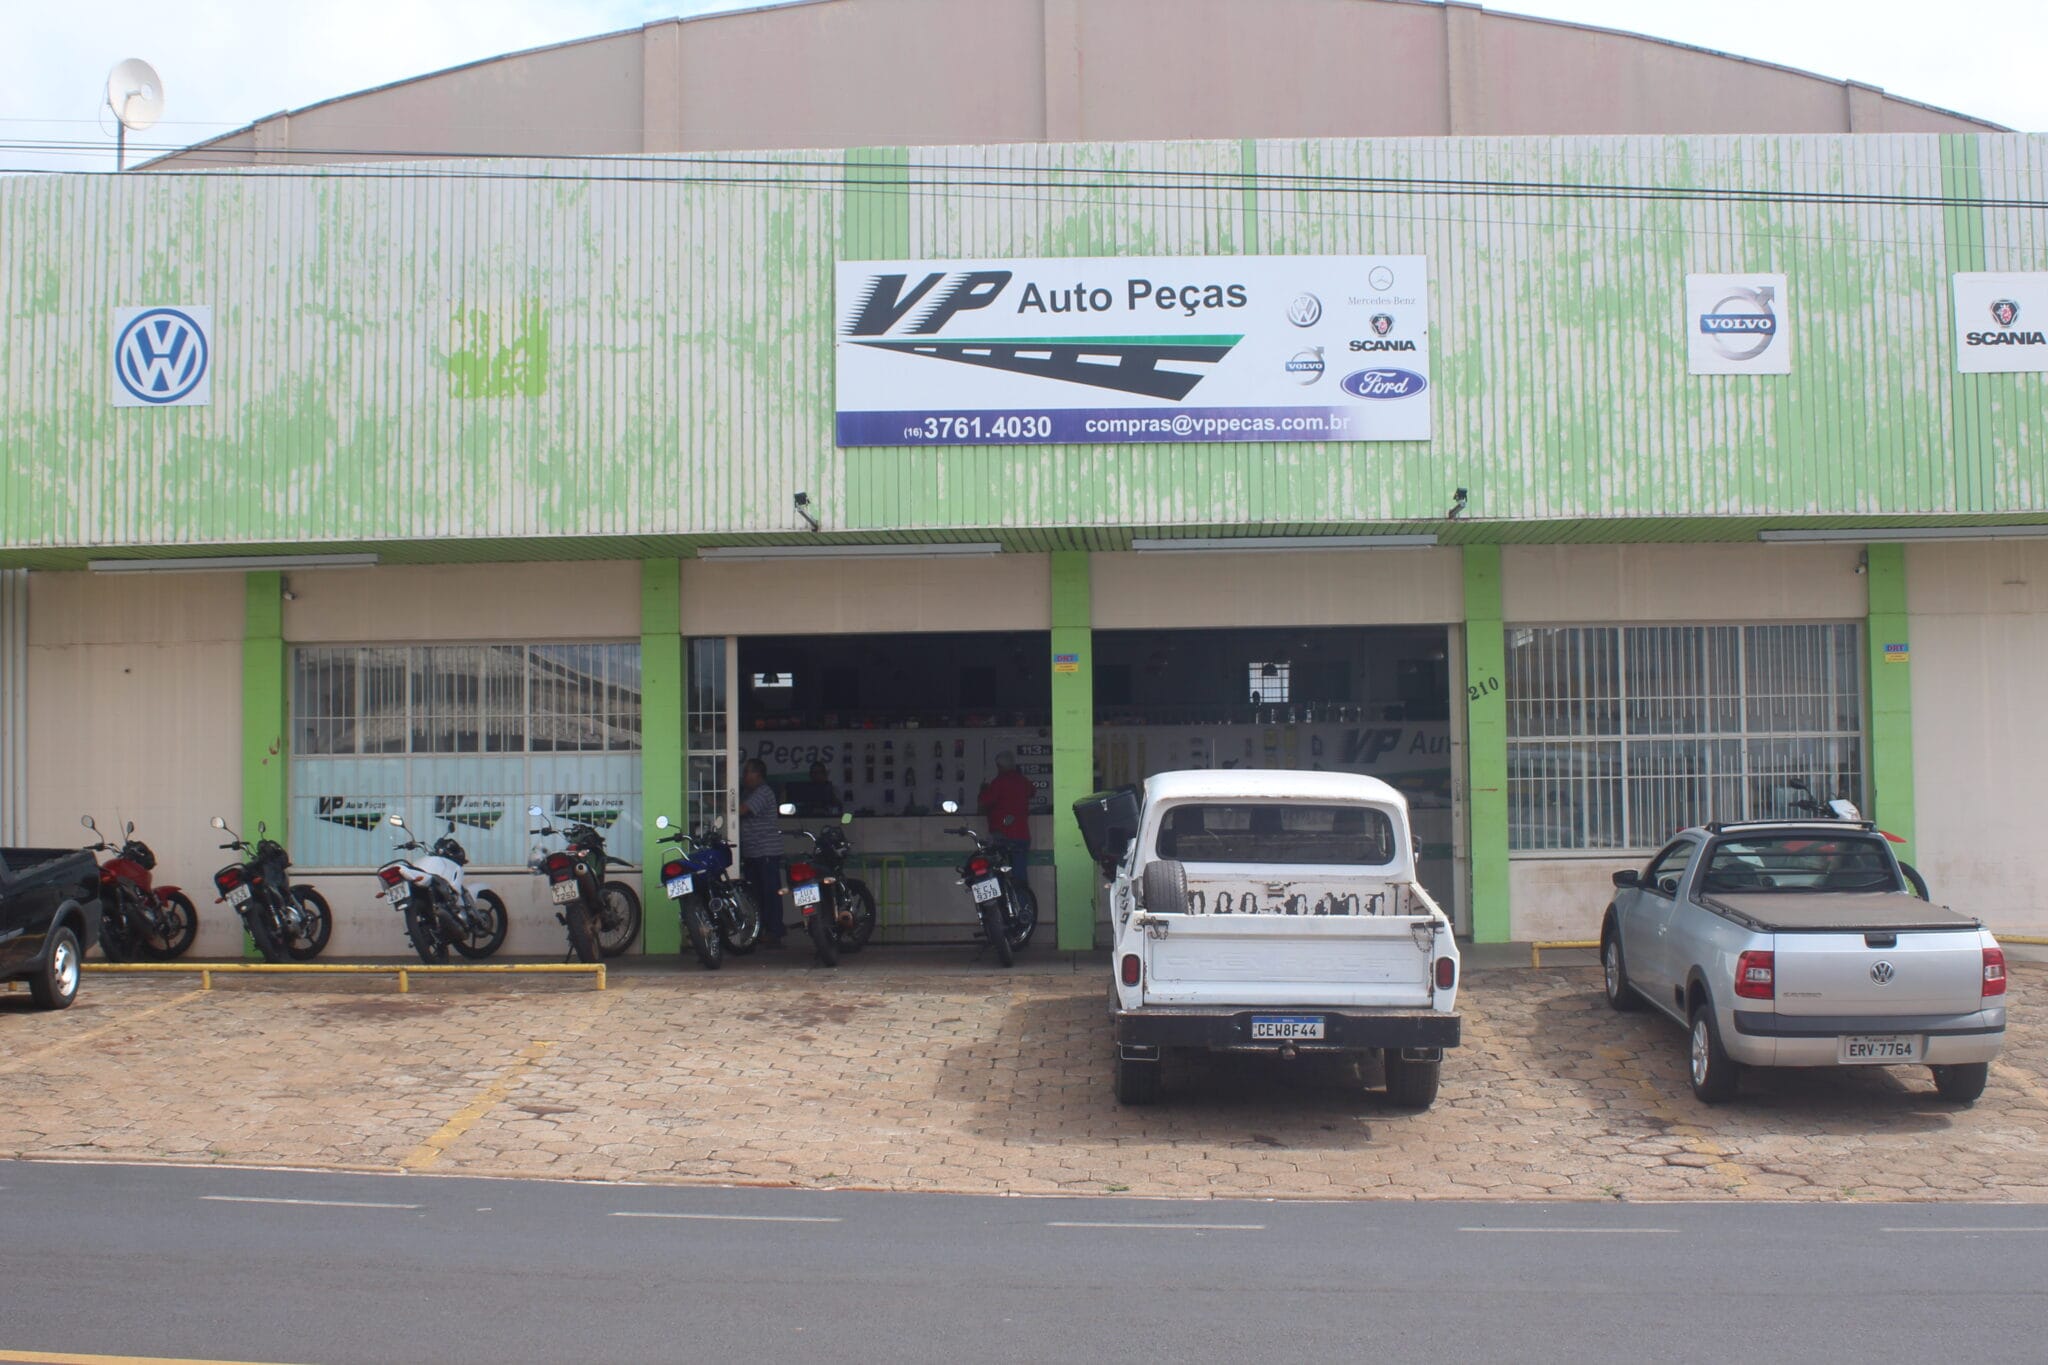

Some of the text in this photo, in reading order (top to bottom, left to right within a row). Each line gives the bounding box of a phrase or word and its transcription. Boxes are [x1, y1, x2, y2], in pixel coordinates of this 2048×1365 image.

[839, 270, 1248, 336] VP Auto Peças
[1705, 318, 1772, 331] VOLVO
[1349, 339, 1416, 353] SCANIA
[1966, 331, 2047, 347] SCANIA
[1288, 362, 1323, 371] VOLVO
[1358, 371, 1409, 395] Ford
[923, 416, 1052, 439] 3761.4030
[1084, 413, 1351, 437] compras@vppecas.com.br
[1468, 676, 1498, 701] 210
[1258, 1023, 1317, 1038] CEW8F44
